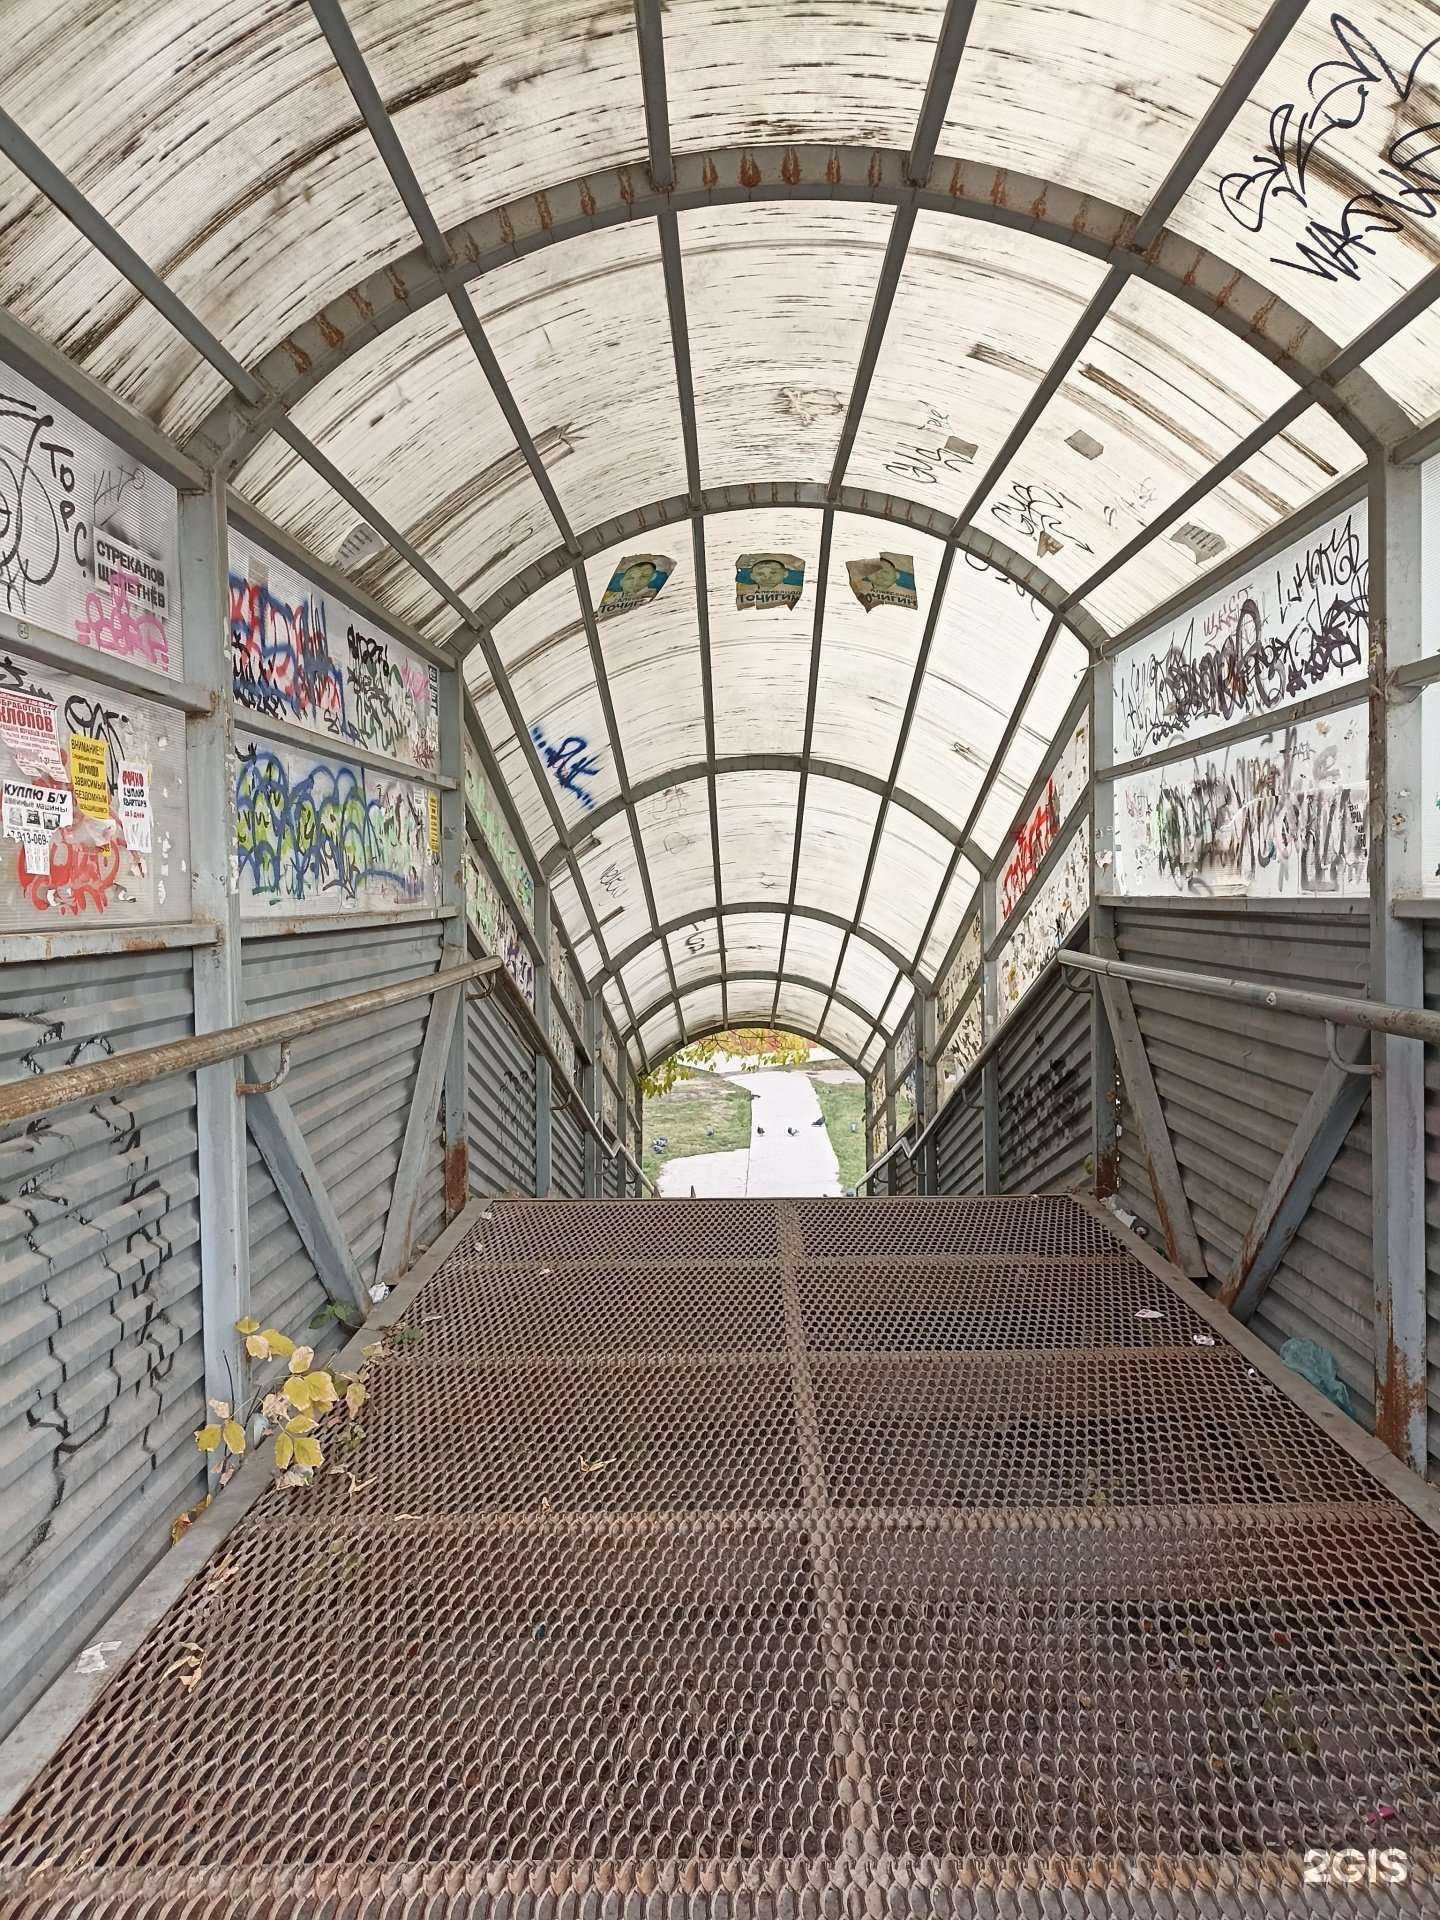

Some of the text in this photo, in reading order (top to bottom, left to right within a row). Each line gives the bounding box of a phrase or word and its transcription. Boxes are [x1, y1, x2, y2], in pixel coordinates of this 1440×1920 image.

[97, 540, 165, 587] СТРЕКАЛОВ
[0, 699, 41, 714] БРАБОТКА
[5, 783, 68, 805] КУПЛЮ Б/У
[36, 802, 68, 813] машины
